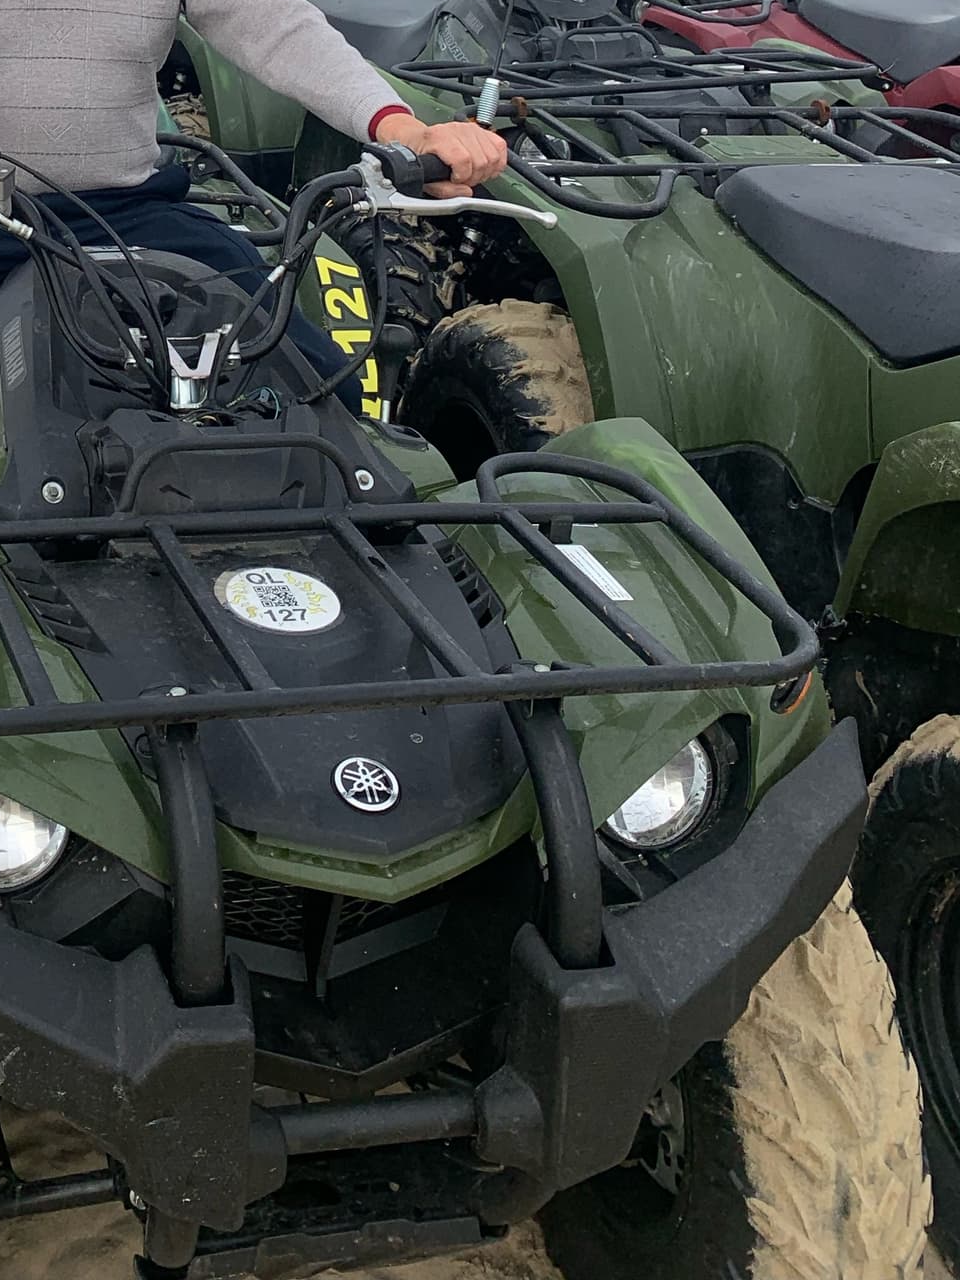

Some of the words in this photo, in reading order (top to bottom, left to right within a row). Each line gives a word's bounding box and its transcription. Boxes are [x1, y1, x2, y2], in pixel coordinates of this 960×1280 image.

[3, 315, 25, 386] YAMAHA
[245, 572, 284, 585] QL
[264, 608, 307, 622] 127
